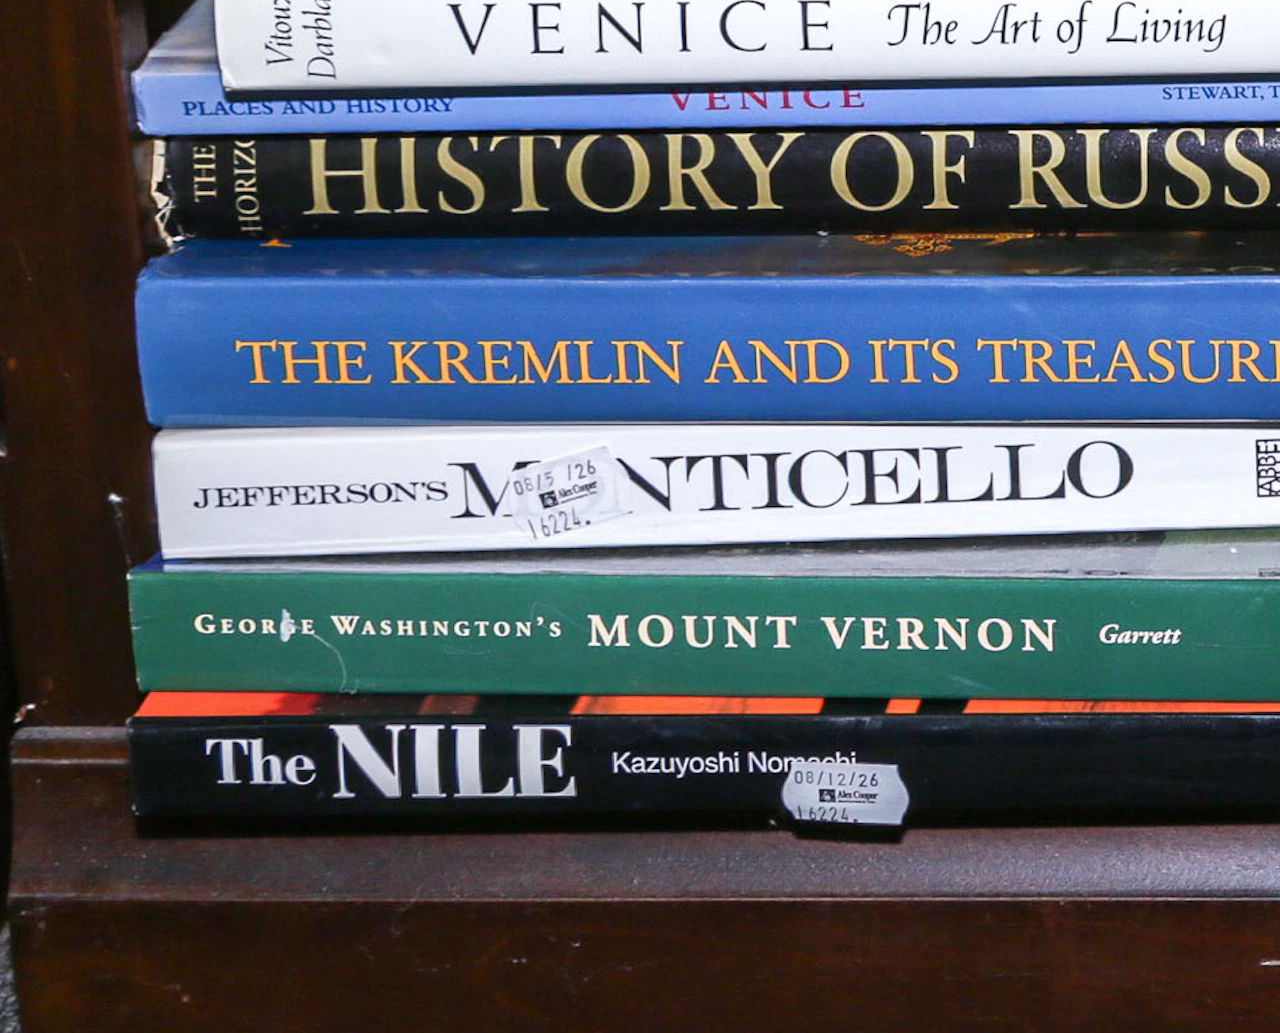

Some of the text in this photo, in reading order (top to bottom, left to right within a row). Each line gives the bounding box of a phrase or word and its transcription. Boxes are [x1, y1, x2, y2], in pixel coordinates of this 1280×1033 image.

[448, 0, 1227, 56] VENICE The Art of Living
[193, 145, 217, 203] THE
[301, 130, 804, 216] HISTORY
[830, 128, 976, 211] OF
[234, 340, 372, 384] THE
[391, 339, 684, 384] KREMLIN
[705, 339, 850, 383] AND
[870, 338, 960, 384] ITS
[193, 480, 449, 510] JEFFERSON'S
[588, 614, 1058, 652] MOUNT VERNON
[1099, 624, 1181, 646] Garrett
[206, 723, 578, 799] The NILE
[612, 750, 740, 779] Kazuyoshi
